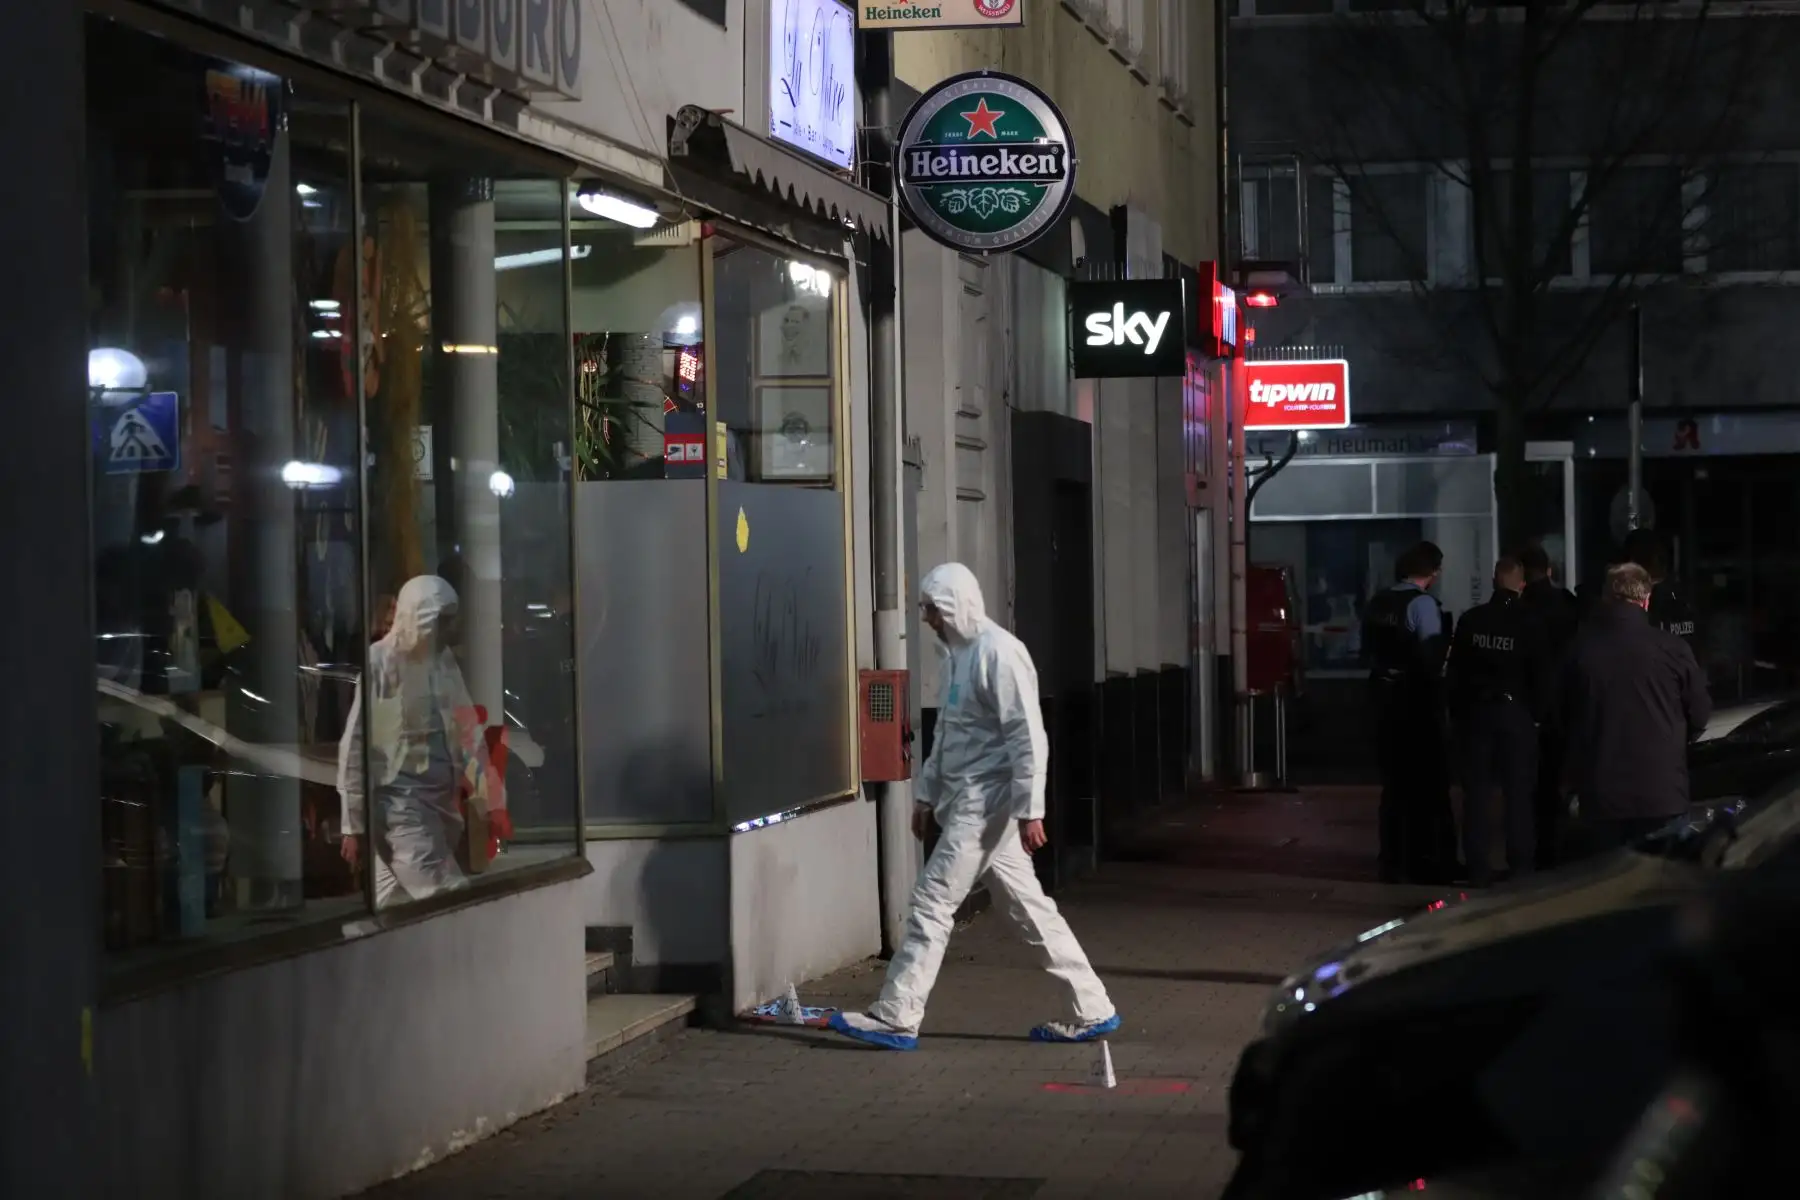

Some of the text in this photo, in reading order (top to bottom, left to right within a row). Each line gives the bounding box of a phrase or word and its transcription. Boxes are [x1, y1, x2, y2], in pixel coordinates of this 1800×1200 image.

[866, 6, 941, 20] Heineken
[911, 149, 1058, 177] Heineken
[1085, 302, 1171, 354] sky
[1249, 379, 1336, 407] tipwin
[1670, 621, 1694, 635] POLIZEI
[1473, 633, 1515, 651] POLIZEI
